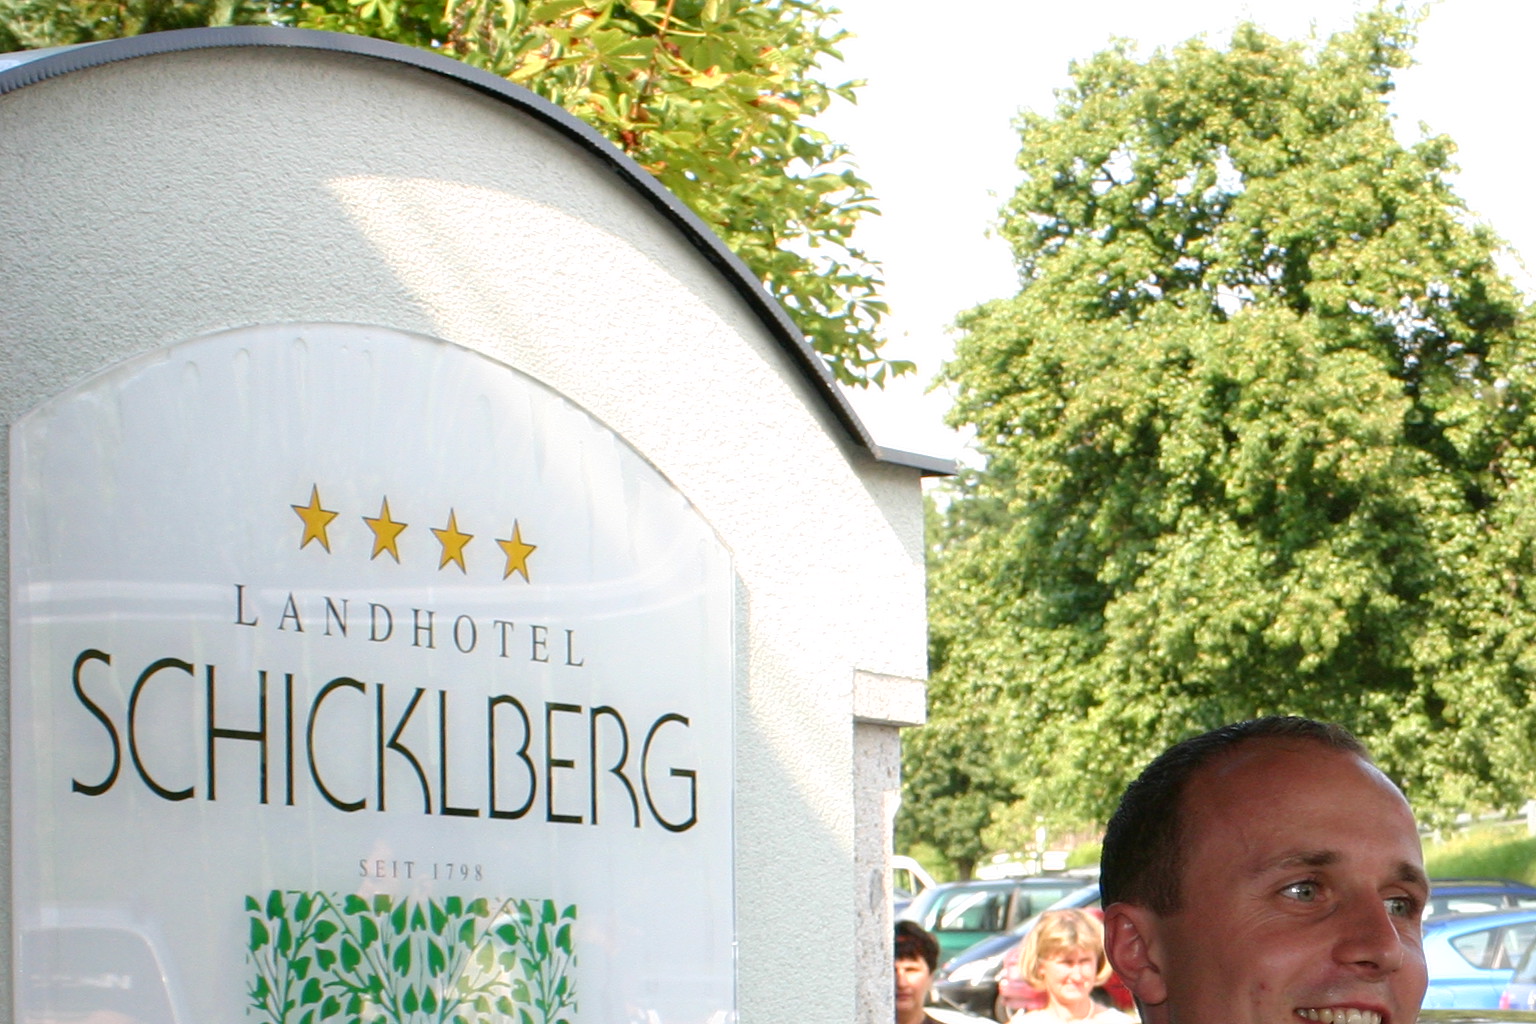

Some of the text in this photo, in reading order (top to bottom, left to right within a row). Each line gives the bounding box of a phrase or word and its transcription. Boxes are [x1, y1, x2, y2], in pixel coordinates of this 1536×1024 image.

[233, 584, 585, 667] LANDHOTEL
[71, 648, 698, 833] SCHICKLBERG
[359, 858, 483, 881] SEIT 1798
